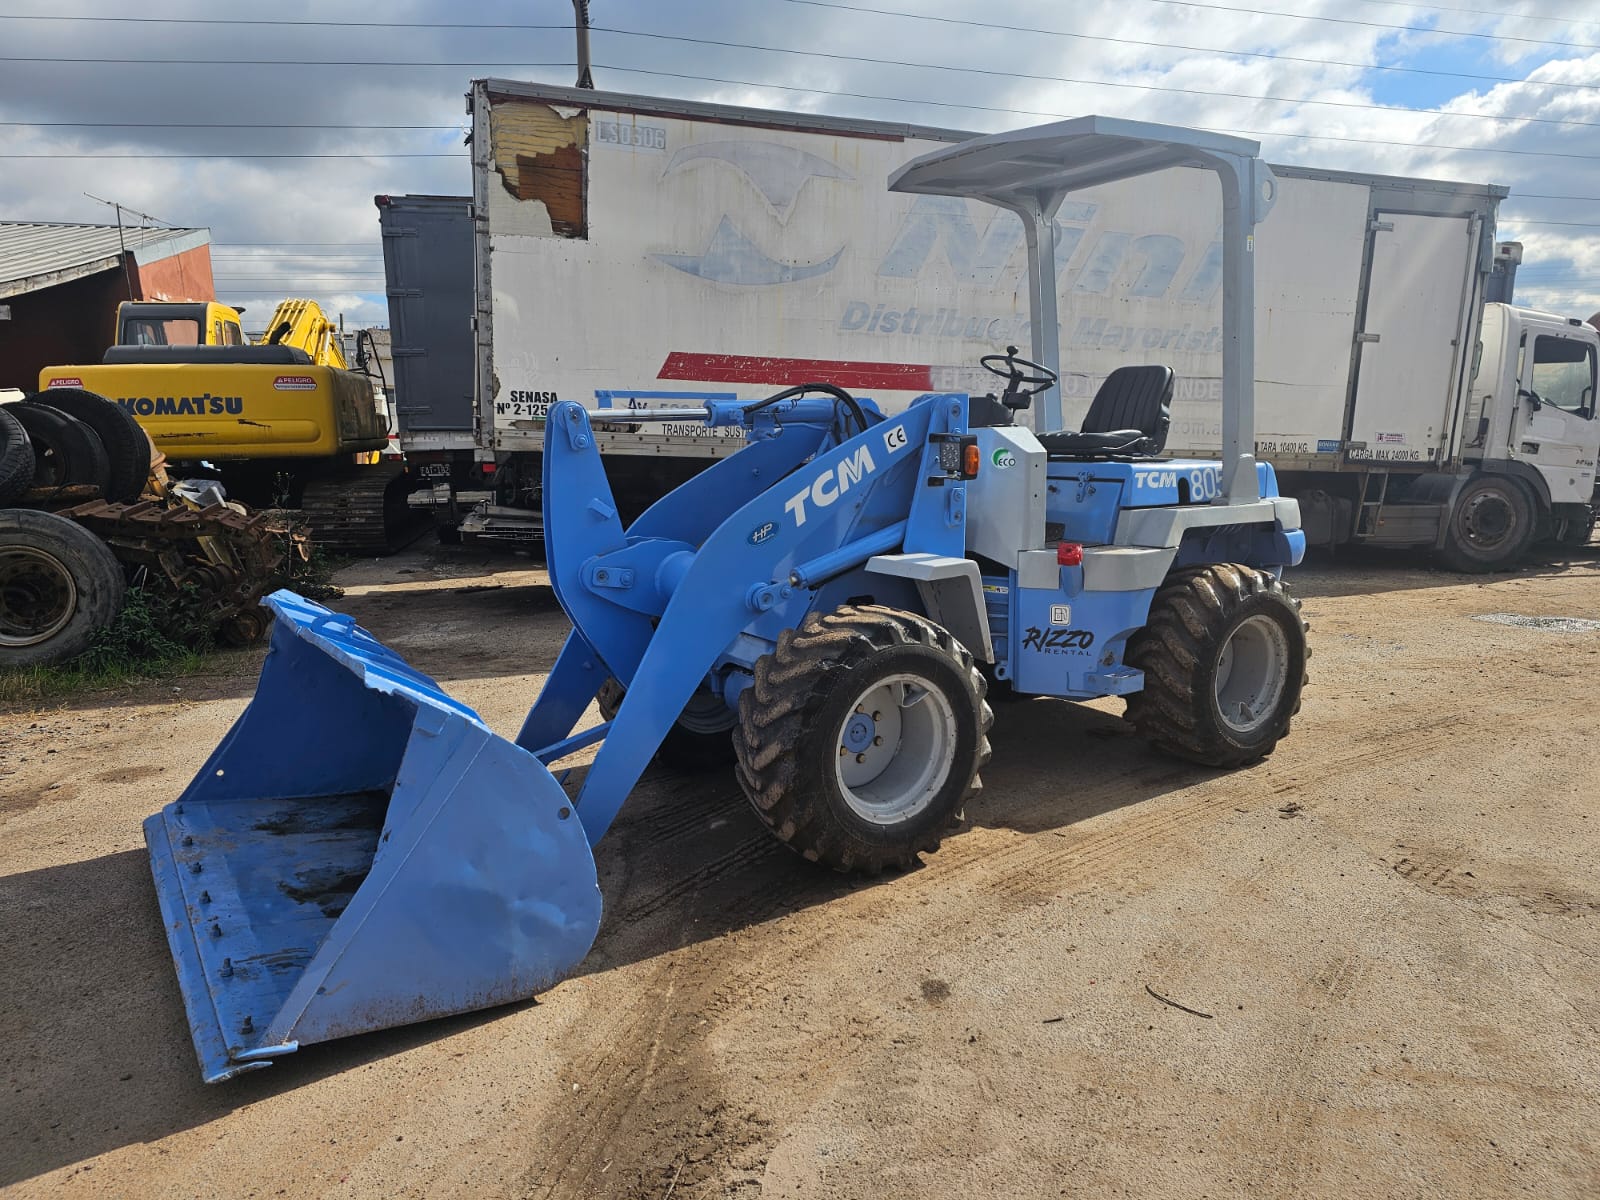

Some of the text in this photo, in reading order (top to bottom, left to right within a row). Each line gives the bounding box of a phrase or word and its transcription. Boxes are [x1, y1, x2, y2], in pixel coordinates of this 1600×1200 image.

[117, 393, 243, 416] KOMATSU
[510, 390, 558, 404] SENASA
[662, 423, 718, 438] TRANSPORTE
[887, 427, 906, 449] CE
[1261, 441, 1276, 453] TARA
[1349, 448, 1374, 460] CARGA
[1376, 449, 1390, 461] MAX
[998, 458, 1016, 467] ECO
[784, 443, 877, 528] TCM
[1134, 471, 1177, 489] TCM
[752, 523, 773, 543] HP
[1022, 626, 1095, 652] RIZZO
[1045, 647, 1092, 656] RENTAL
